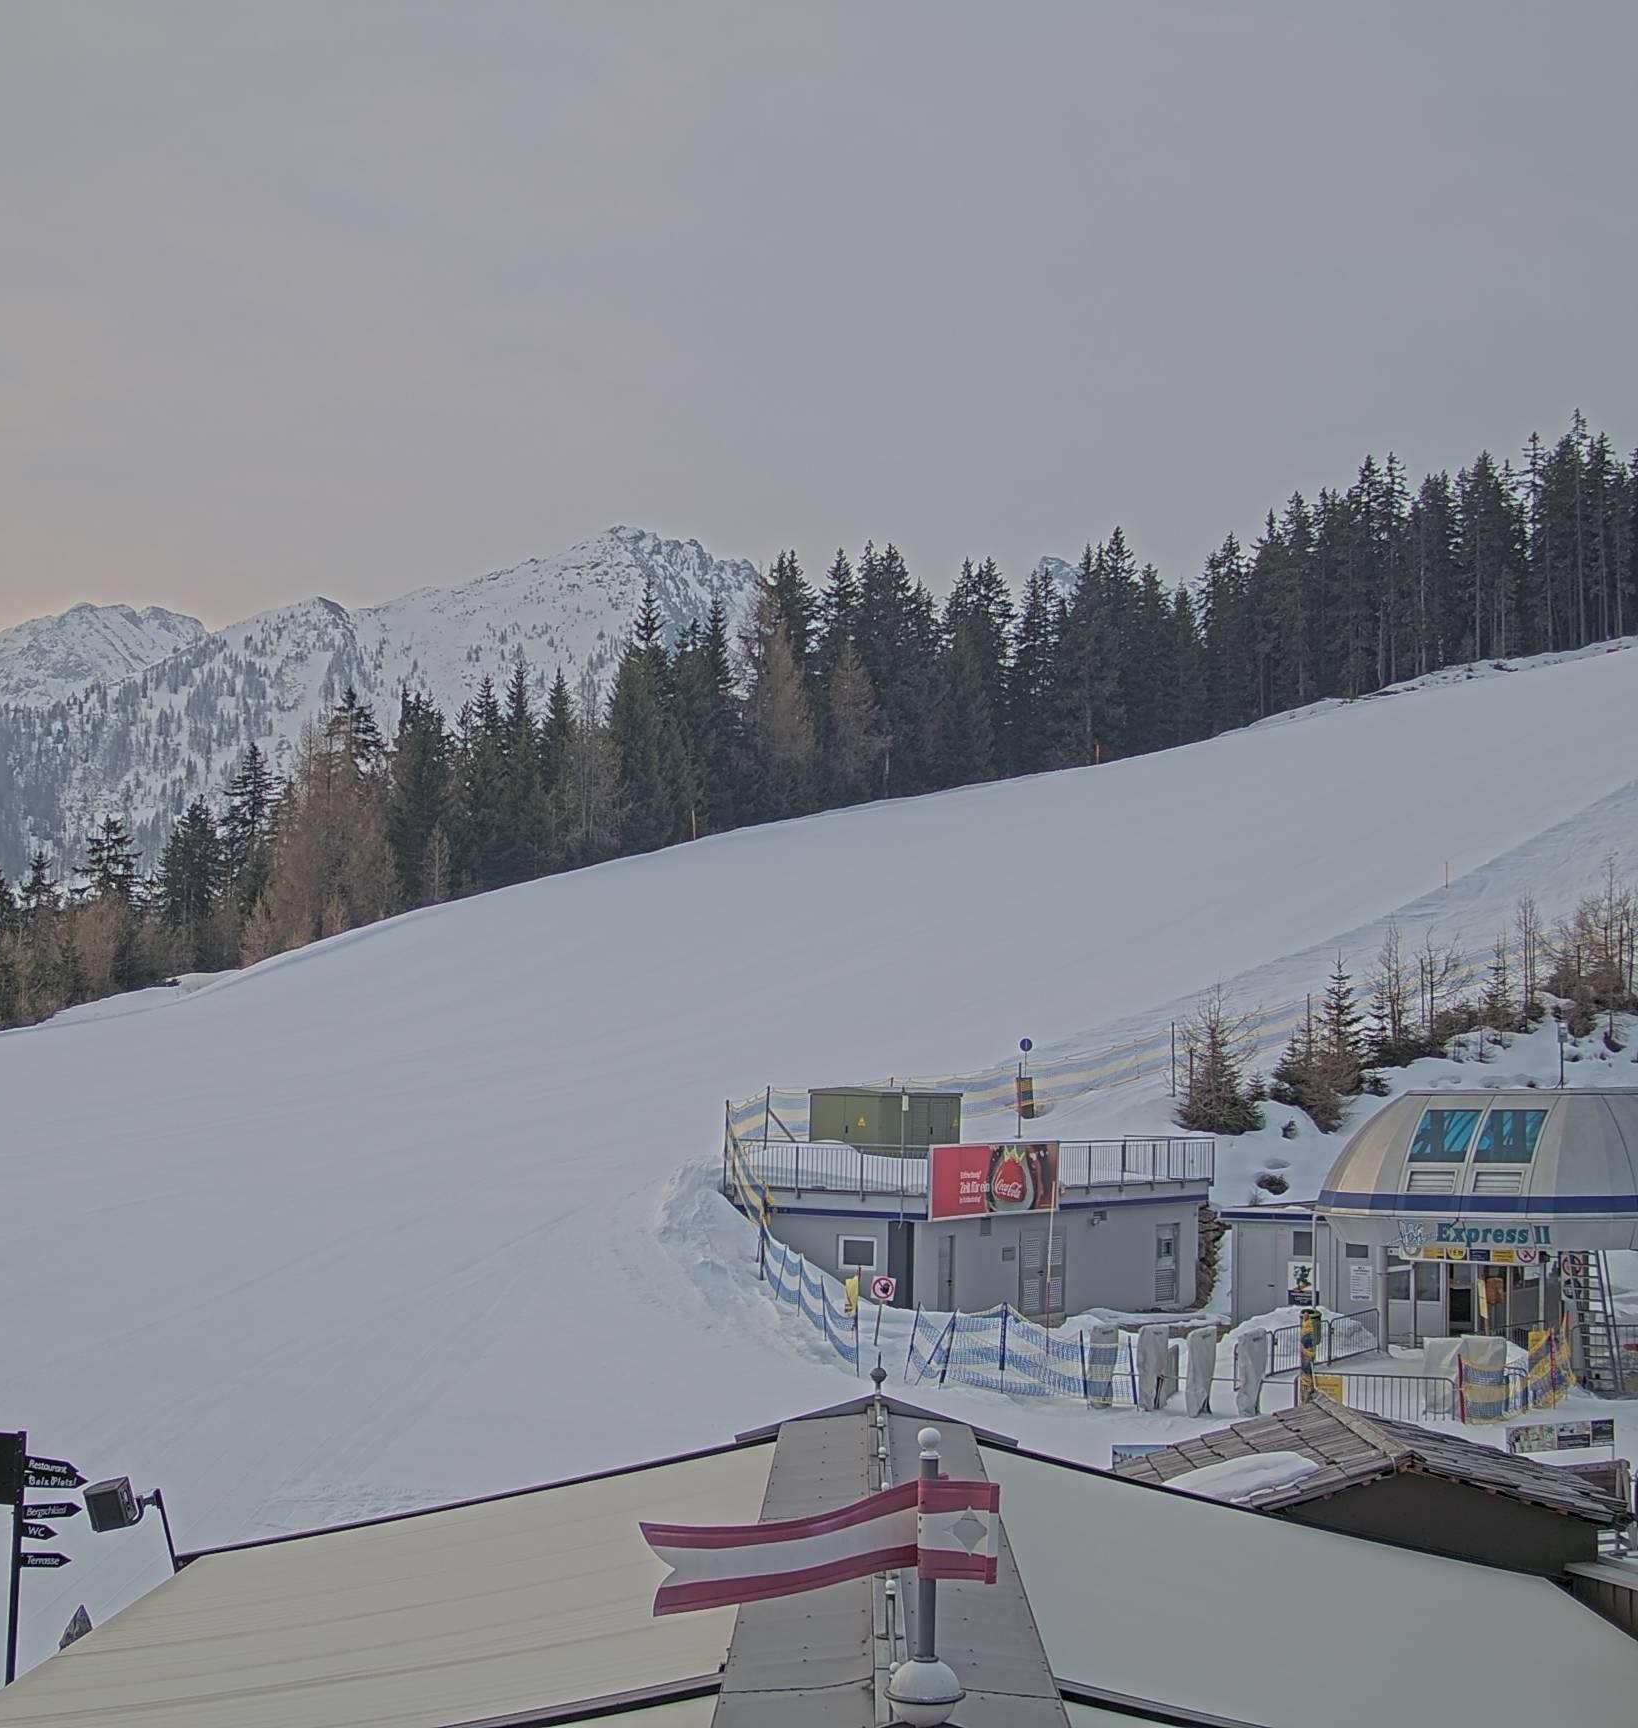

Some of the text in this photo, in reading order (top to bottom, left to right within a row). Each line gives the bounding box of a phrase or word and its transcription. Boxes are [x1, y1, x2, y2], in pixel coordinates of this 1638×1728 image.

[1436, 1222, 1529, 1248] Express
[28, 1526, 46, 1537] WC
[26, 1555, 60, 1566] Terrasse
